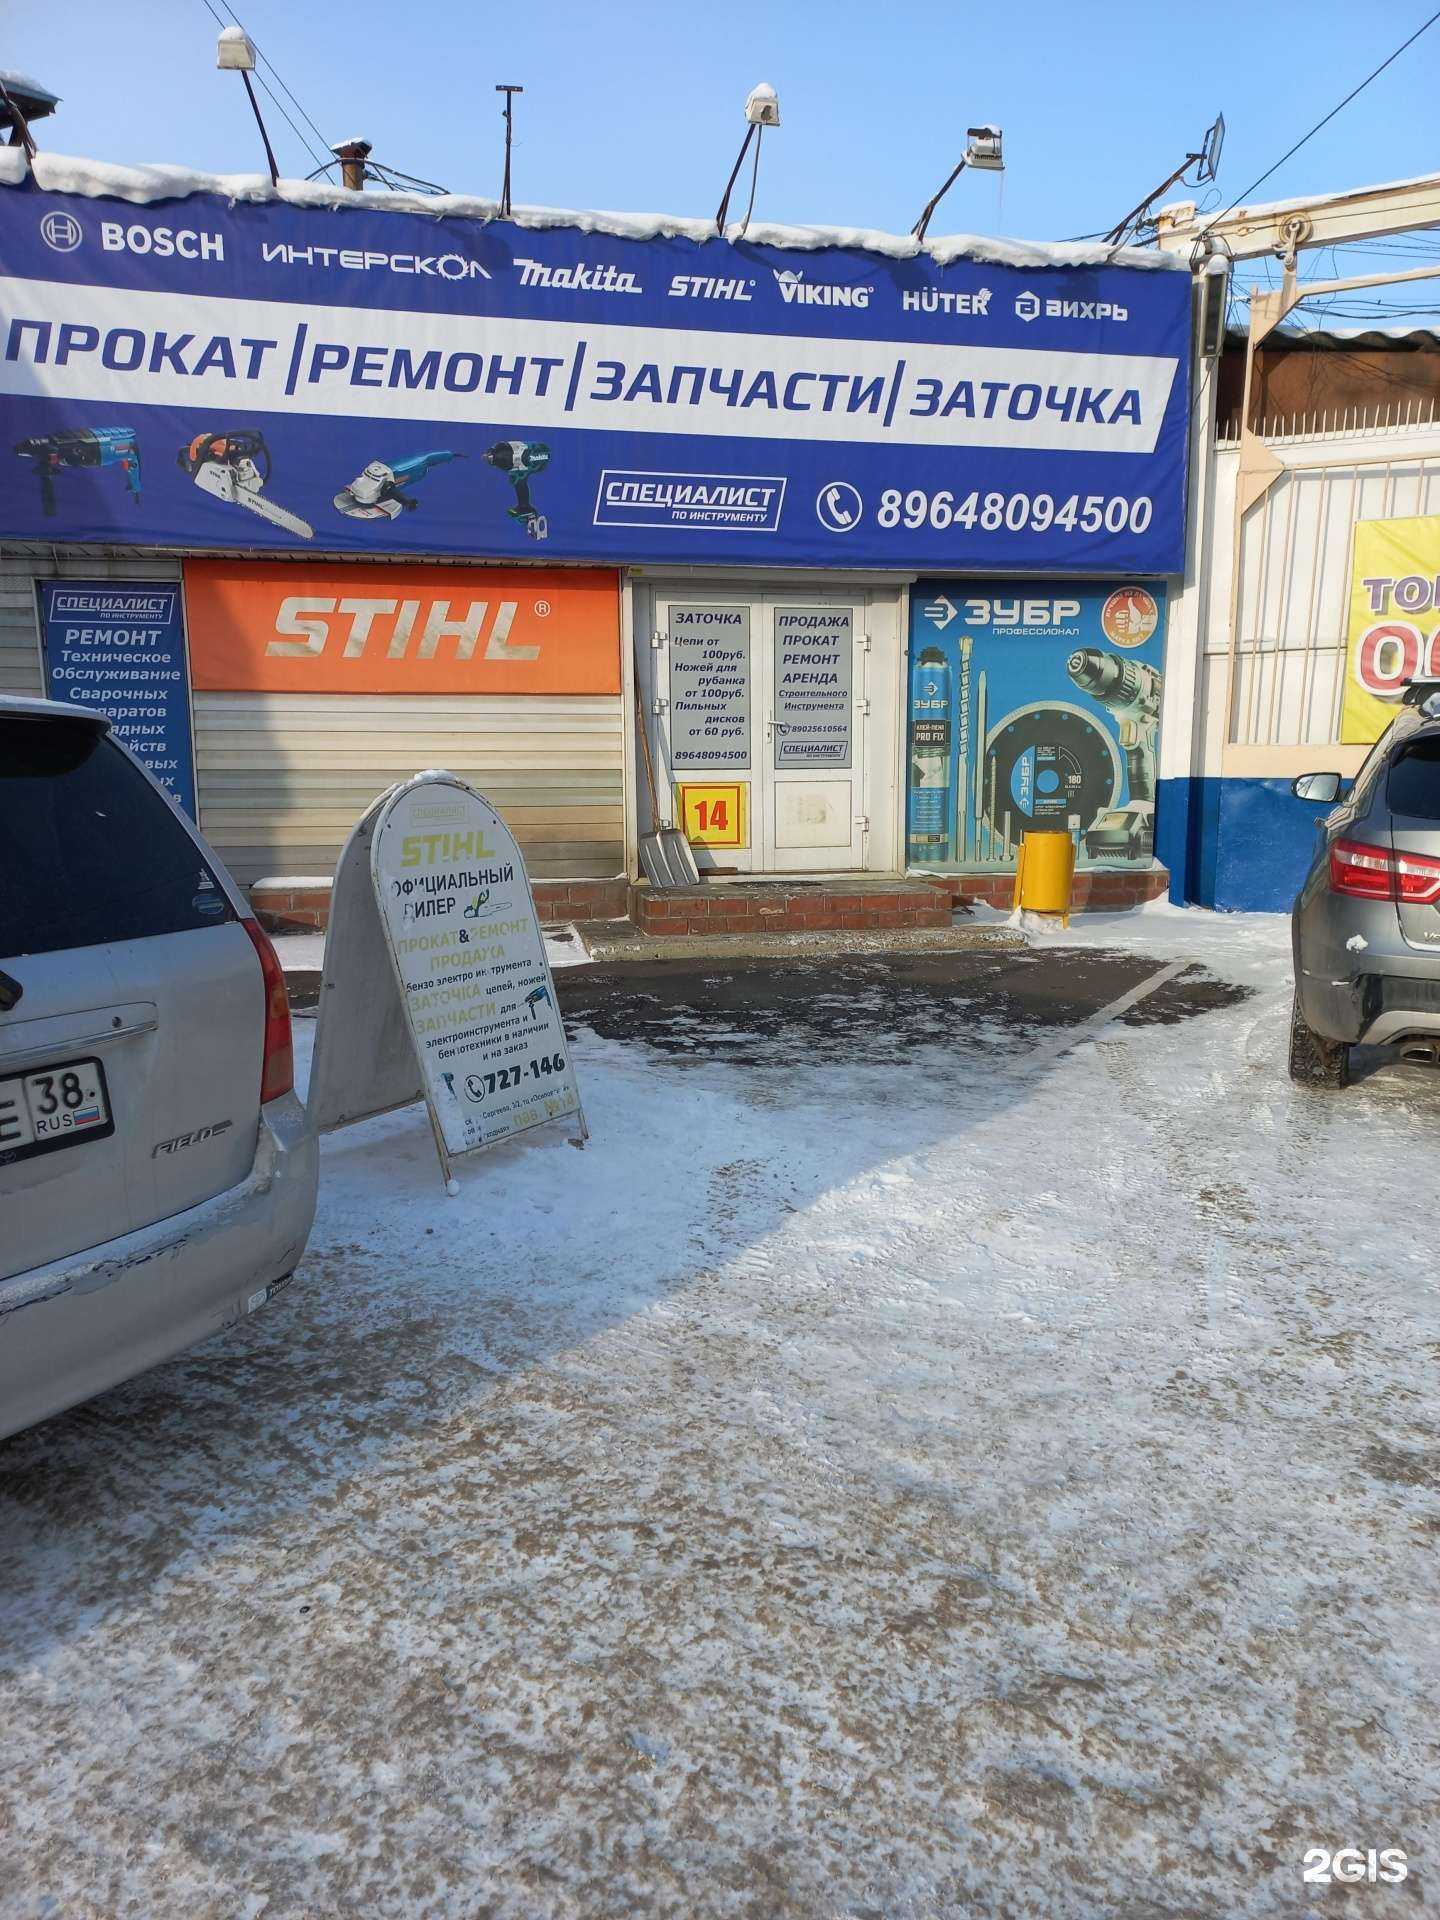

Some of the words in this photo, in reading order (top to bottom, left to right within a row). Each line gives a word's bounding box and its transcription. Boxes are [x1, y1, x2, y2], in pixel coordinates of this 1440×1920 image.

[102, 222, 224, 261] BOSCH
[262, 242, 492, 281] ИНТЕРСКОЛ
[777, 281, 869, 308] VIKING
[903, 287, 991, 315] HÜTER
[1046, 299, 1128, 322] ВИХРЬ
[5, 318, 278, 380] ПРОКАТ
[307, 343, 565, 396] РЕМОНТ
[590, 361, 889, 413] ЗАПЧАСТИ
[909, 378, 1142, 425] ЗАТОЧКА
[606, 481, 776, 507] СПЕЦИАЛИСТ
[671, 510, 686, 520] ПО
[688, 511, 768, 523] ИНСТРУМЕНТУ
[877, 488, 1153, 534] 89648094500
[56, 596, 167, 611] СПЕЦИАЛИСТ
[964, 599, 1081, 625] ЗУБР
[675, 613, 742, 625] ЗАТОЧКА
[778, 616, 849, 628] ПРОДАЖА
[65, 629, 161, 646] РЕМОНТ
[992, 627, 1080, 636] ПРОФЕССИОНАЛ
[674, 637, 704, 647] Цепи
[782, 635, 839, 646] ПРОКАТ
[61, 650, 171, 663] Техническое
[702, 650, 745, 661] 100руб.
[782, 654, 840, 665] РЕМОНТ
[674, 662, 714, 672] Ножей
[716, 664, 737, 673] для
[52, 667, 181, 682] Обслуживание
[782, 673, 838, 685] АРЕНДА
[698, 676, 745, 687] рубанка
[69, 687, 168, 701] Сварочных
[685, 690, 698, 698] от
[701, 689, 745, 700] 100руб.
[778, 689, 848, 698] Строительного
[675, 702, 727, 711] Пильных
[784, 702, 845, 711] Инструмента
[913, 700, 949, 709] ЗУБР
[97, 706, 167, 719] паратов
[705, 715, 745, 724] дисков
[109, 724, 166, 736] ядных
[704, 727, 719, 736] 60
[721, 727, 745, 738] руб.
[916, 732, 931, 741] PRO
[932, 732, 945, 741] FIX
[783, 744, 845, 753] СПЕЦИАЛИСТ
[674, 751, 748, 760] 89648094500
[694, 800, 729, 831] 14
[400, 829, 496, 868] STIHL
[459, 928, 470, 944] &
[436, 973, 473, 986] электро
[411, 983, 481, 1013] ЗАТОЧКА
[485, 981, 516, 995] цепей,
[517, 974, 547, 988] ножей
[416, 1002, 498, 1035] ЗАПЧАСТИ
[500, 1003, 517, 1015] для
[425, 1018, 520, 1049] электроинструмента
[512, 1022, 549, 1040] наличии
[491, 1050, 502, 1059] на
[504, 1042, 528, 1056] заказ
[484, 1053, 566, 1095] 727-146
[32, 1072, 84, 1115] 38
[36, 1114, 73, 1133] RUS
